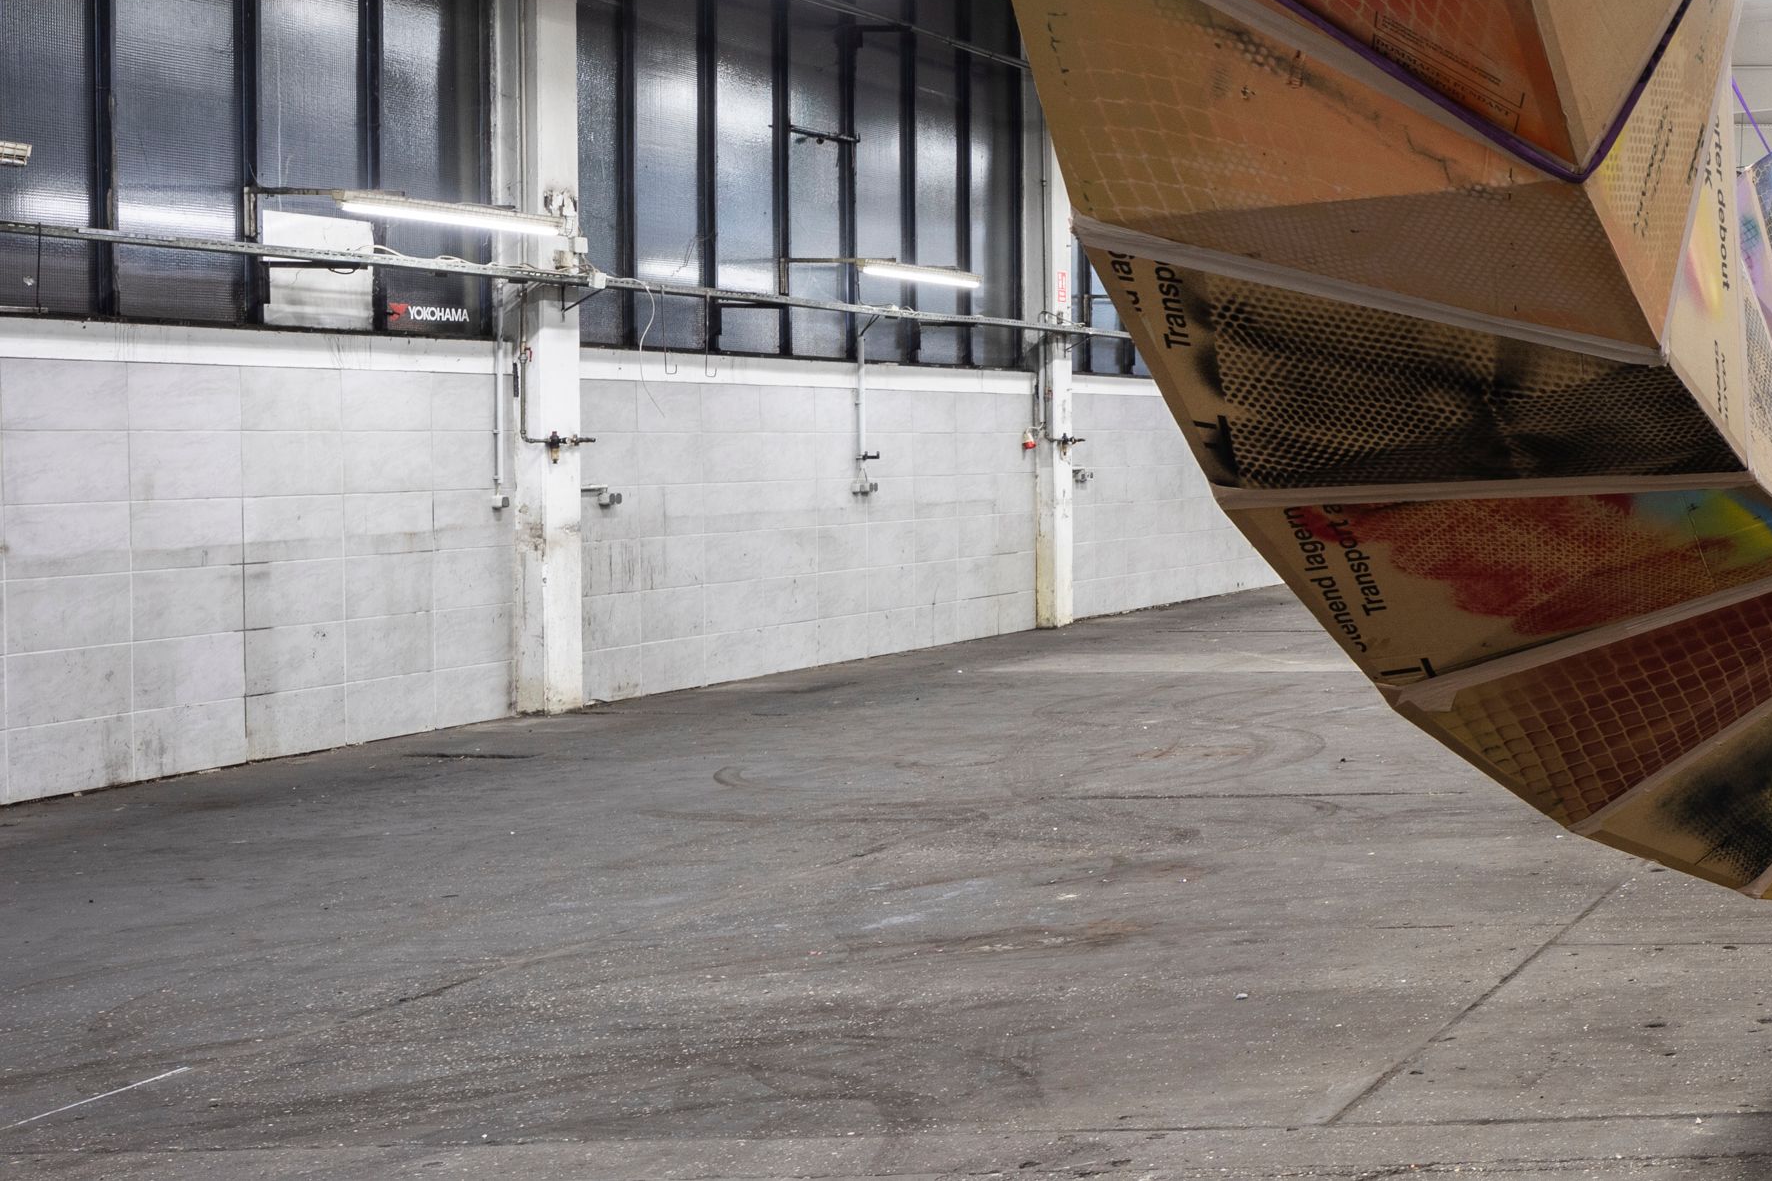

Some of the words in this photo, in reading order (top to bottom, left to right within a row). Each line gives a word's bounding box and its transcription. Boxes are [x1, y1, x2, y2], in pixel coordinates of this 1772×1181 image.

[1718, 187, 1731, 292] debout
[408, 305, 470, 322] YOKOHAMA
[1284, 507, 1328, 571] lagern
[1327, 519, 1387, 617] Transport
